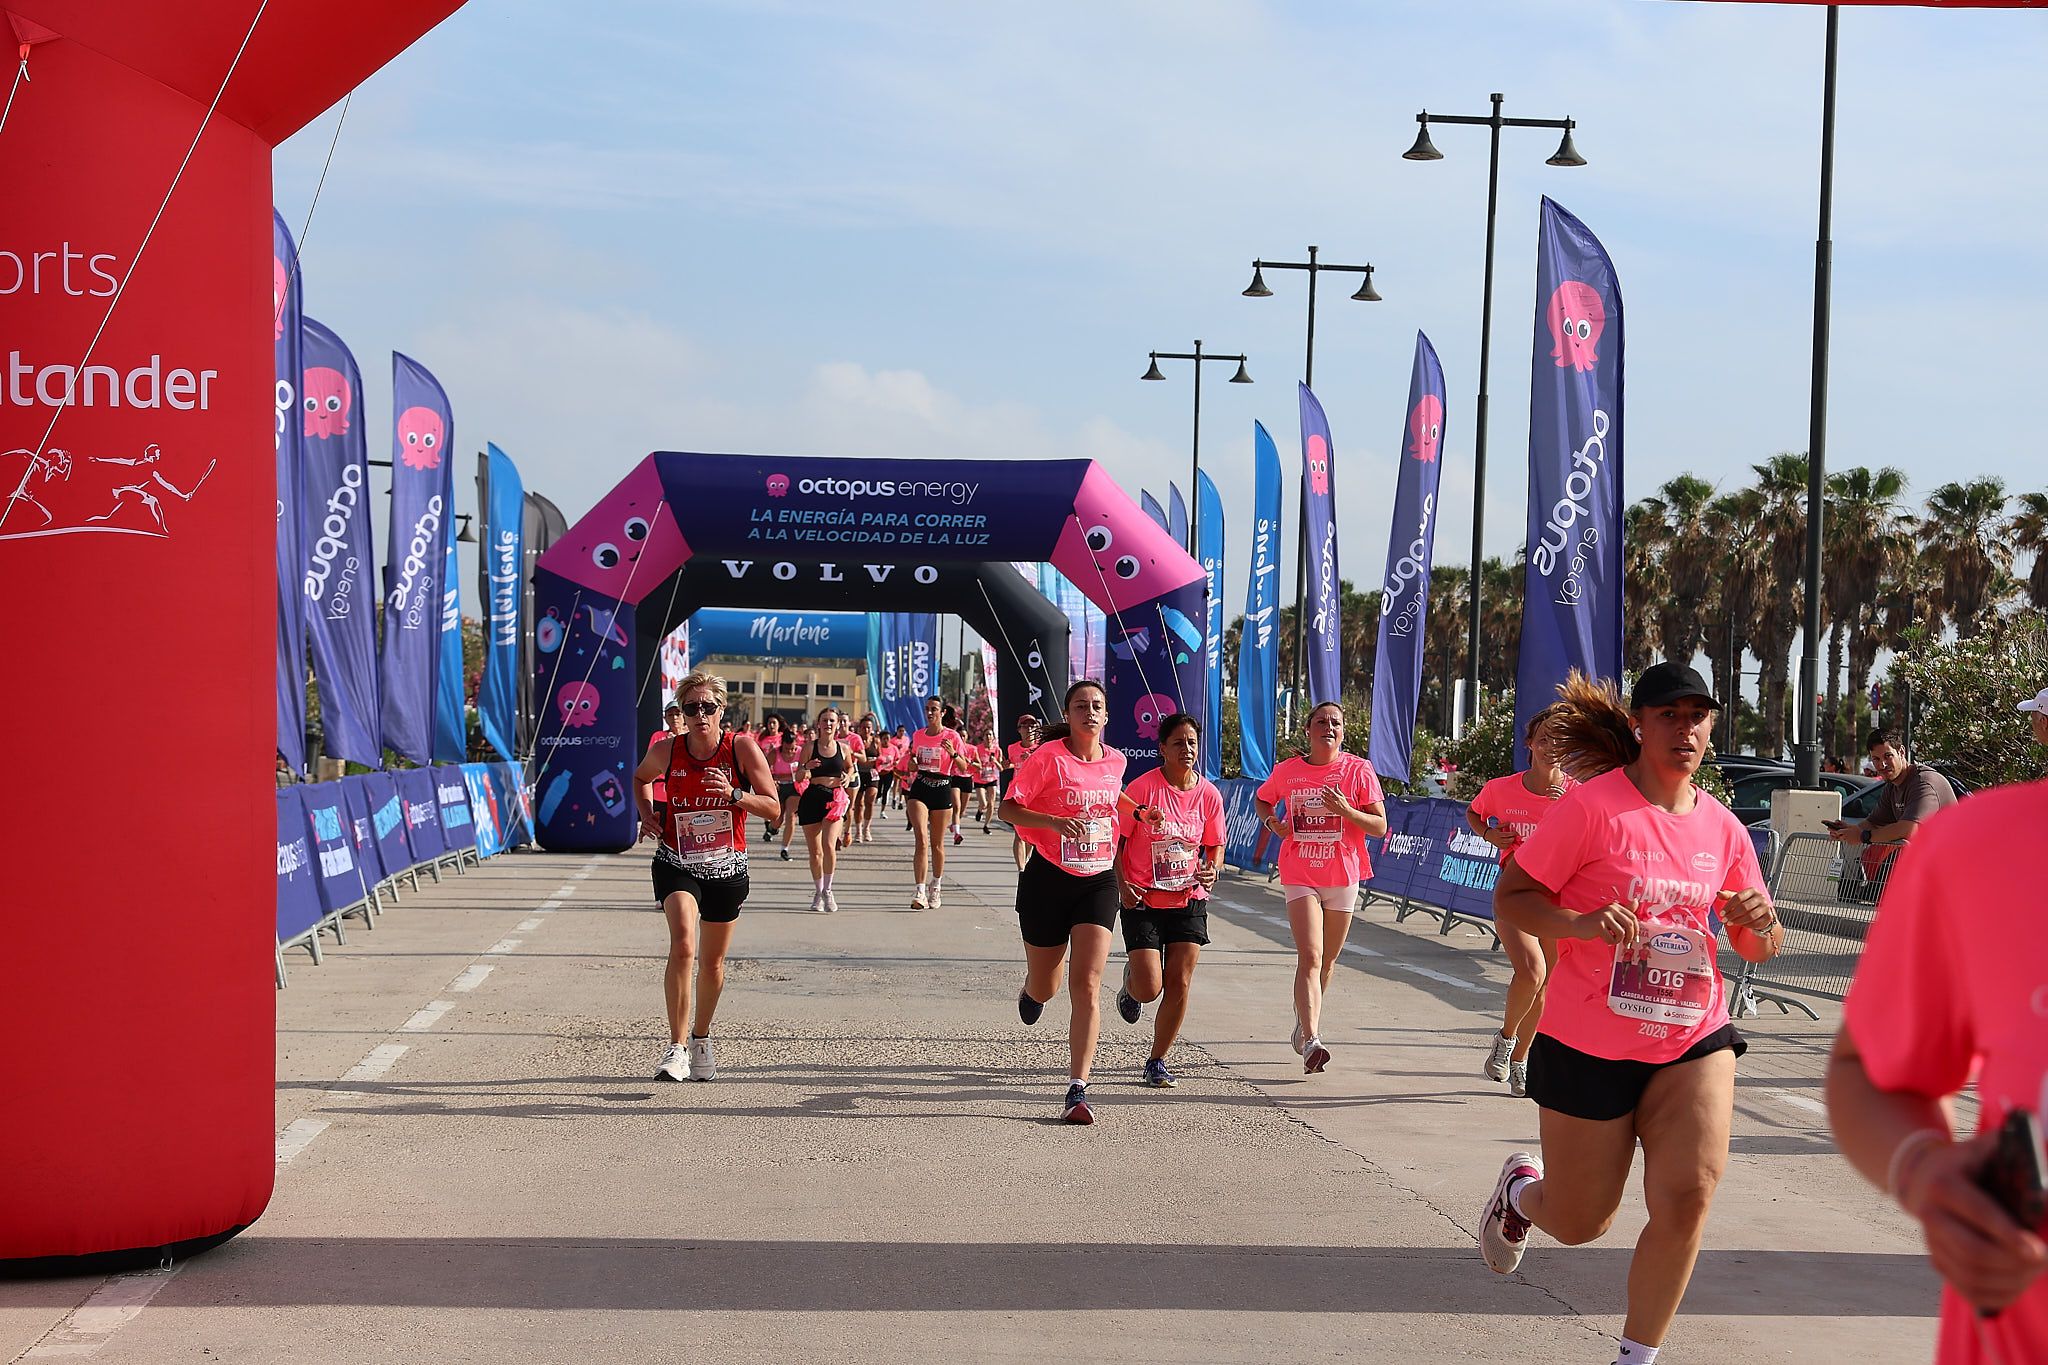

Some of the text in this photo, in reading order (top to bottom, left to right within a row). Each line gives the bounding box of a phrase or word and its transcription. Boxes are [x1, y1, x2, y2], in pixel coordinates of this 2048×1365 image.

[0, 350, 217, 410] tander
[799, 477, 979, 505] octopus energy
[750, 508, 986, 528] LA ENERGÍA PARA CORRER
[747, 527, 990, 545] A LA VELOCIDAD DE LA LUZ
[721, 559, 939, 585] VOLVO
[750, 615, 830, 651] Marlene
[540, 735, 622, 749] octopus energy
[1116, 747, 1158, 759] topus
[1066, 789, 1117, 806] CARRERA
[1306, 816, 1326, 825] 016
[695, 833, 716, 844] 016
[1080, 842, 1099, 852] 016
[1298, 845, 1336, 859] MUJER
[1626, 849, 1665, 862] OYSHO
[1170, 860, 1188, 870] 016
[1627, 875, 1711, 908] CARRERA
[1653, 938, 1690, 952] ASTURIANA
[1647, 968, 1685, 988] 016
[1619, 1002, 1654, 1014] OYSHO
[1637, 1022, 1668, 1039] 2026
